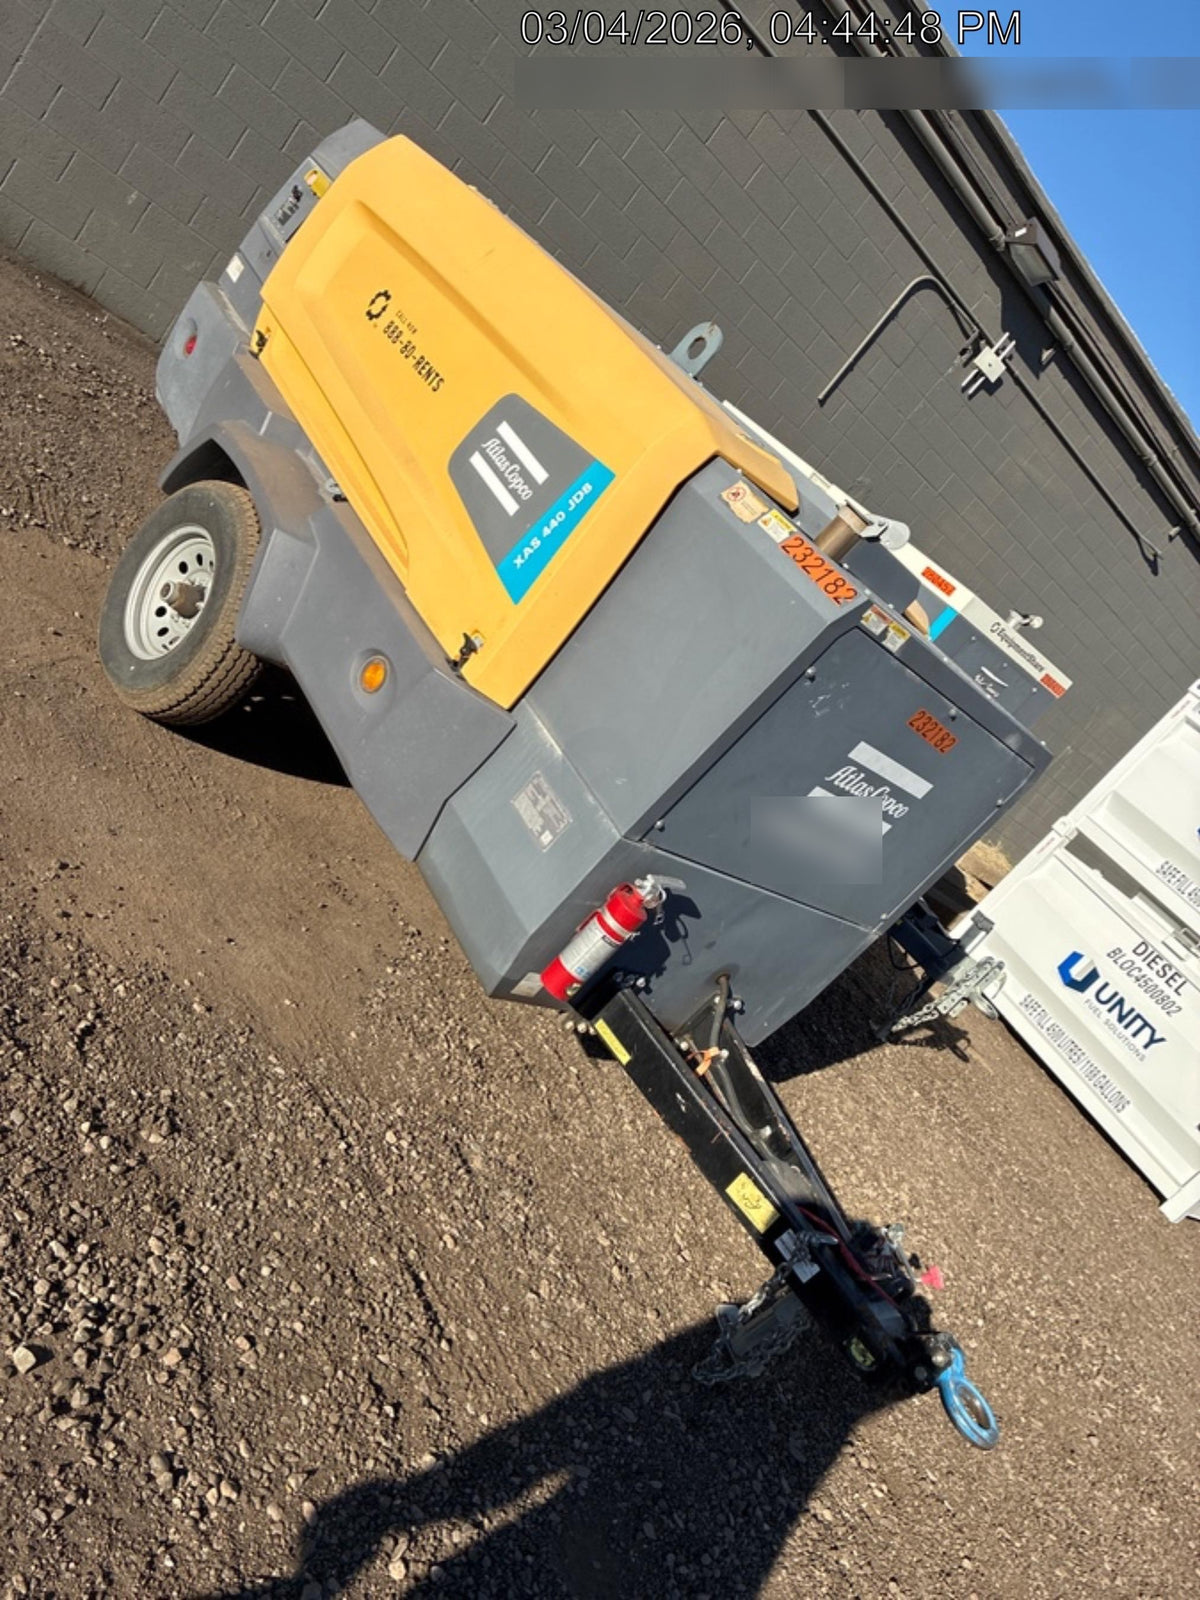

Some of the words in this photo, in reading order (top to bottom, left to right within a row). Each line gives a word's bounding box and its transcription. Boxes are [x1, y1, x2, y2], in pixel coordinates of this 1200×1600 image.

[383, 320, 445, 392] 888-80-RENTS
[513, 537, 541, 569] XAS
[542, 511, 566, 538] 440
[781, 536, 857, 605] 232182
[908, 710, 957, 753] 232182
[1132, 941, 1187, 996] DIESEL
[1085, 998, 1103, 1019] FUEL
[1103, 1018, 1146, 1062] SOLUTIONS
[1095, 981, 1167, 1050] UNITY
